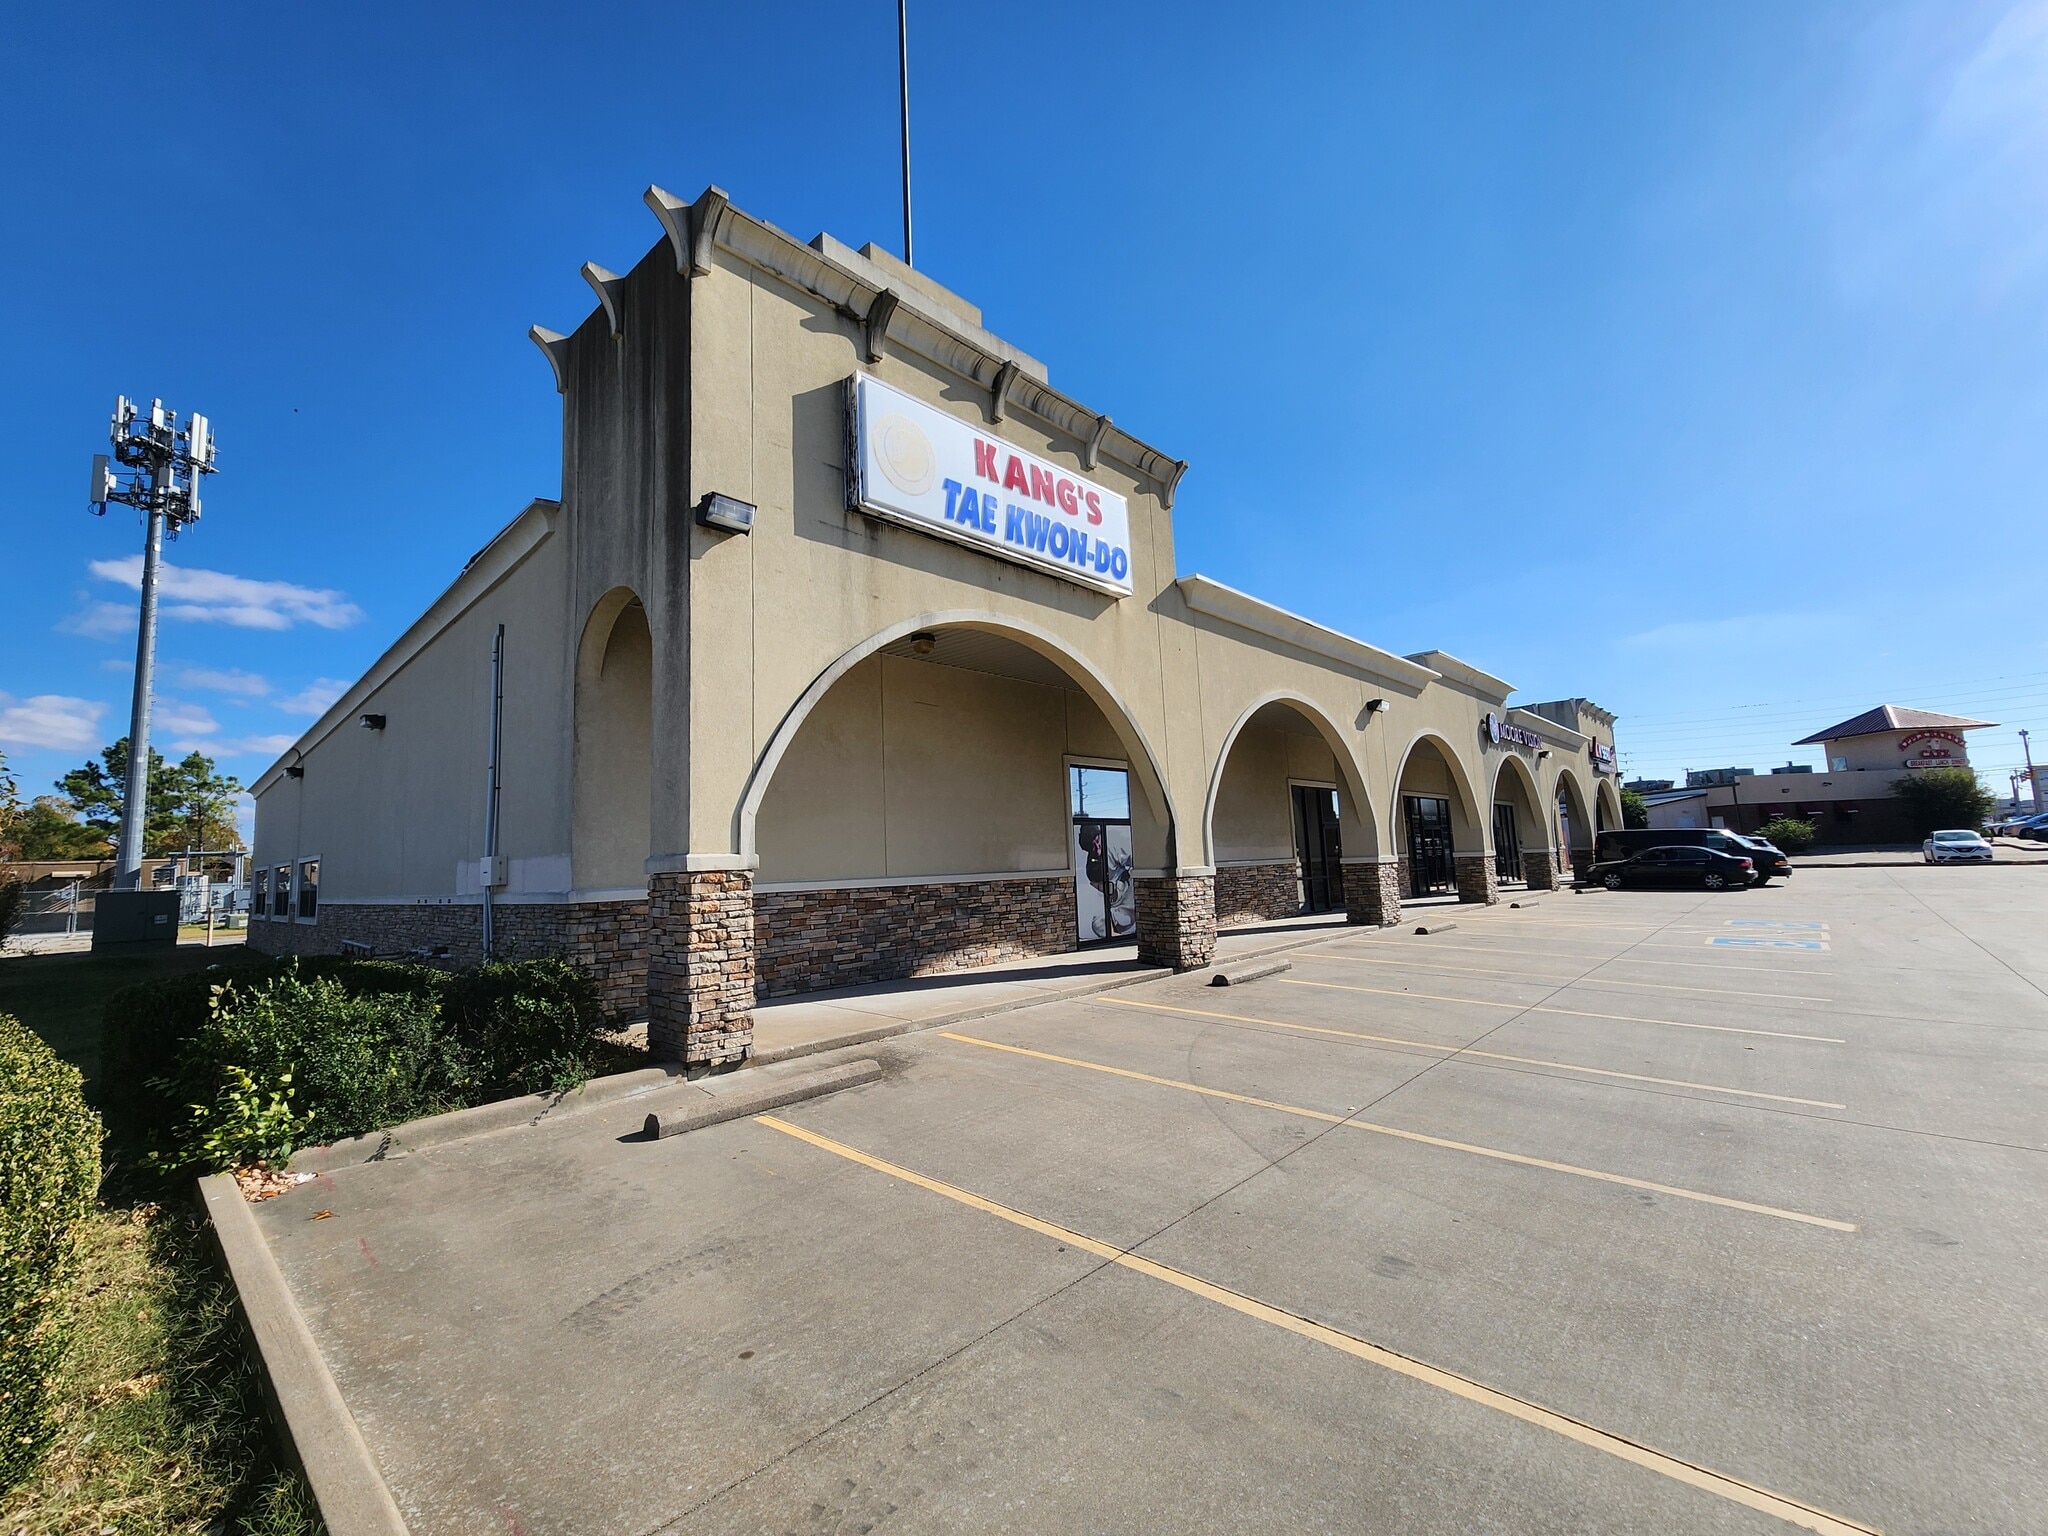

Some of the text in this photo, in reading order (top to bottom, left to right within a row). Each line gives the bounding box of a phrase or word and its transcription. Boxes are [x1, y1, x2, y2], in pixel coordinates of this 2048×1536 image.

[975, 438, 1103, 526] KANG'S
[942, 478, 1127, 580] TAE KWON-DO
[1500, 723, 1523, 744] MOORE
